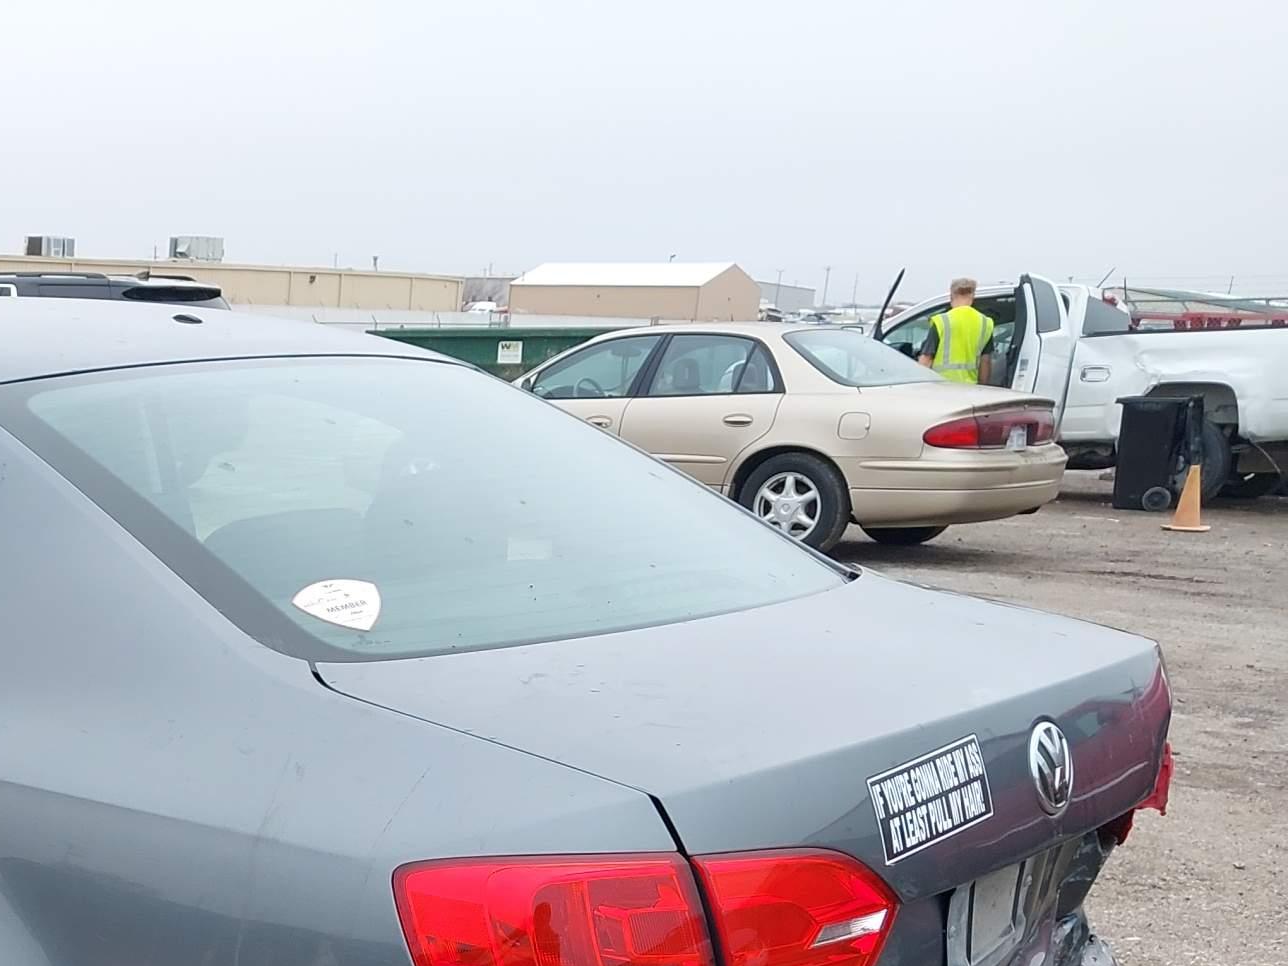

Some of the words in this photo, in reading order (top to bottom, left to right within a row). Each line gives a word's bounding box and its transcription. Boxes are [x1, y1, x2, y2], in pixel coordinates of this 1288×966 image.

[872, 783, 886, 820] IF
[910, 760, 943, 803] GONNA
[935, 752, 959, 792] RIDE
[952, 747, 969, 784] MY
[964, 742, 983, 779] ASS
[889, 816, 904, 854] AT
[900, 804, 931, 848] LEAST
[927, 795, 953, 836] PULL
[948, 788, 965, 826] MY
